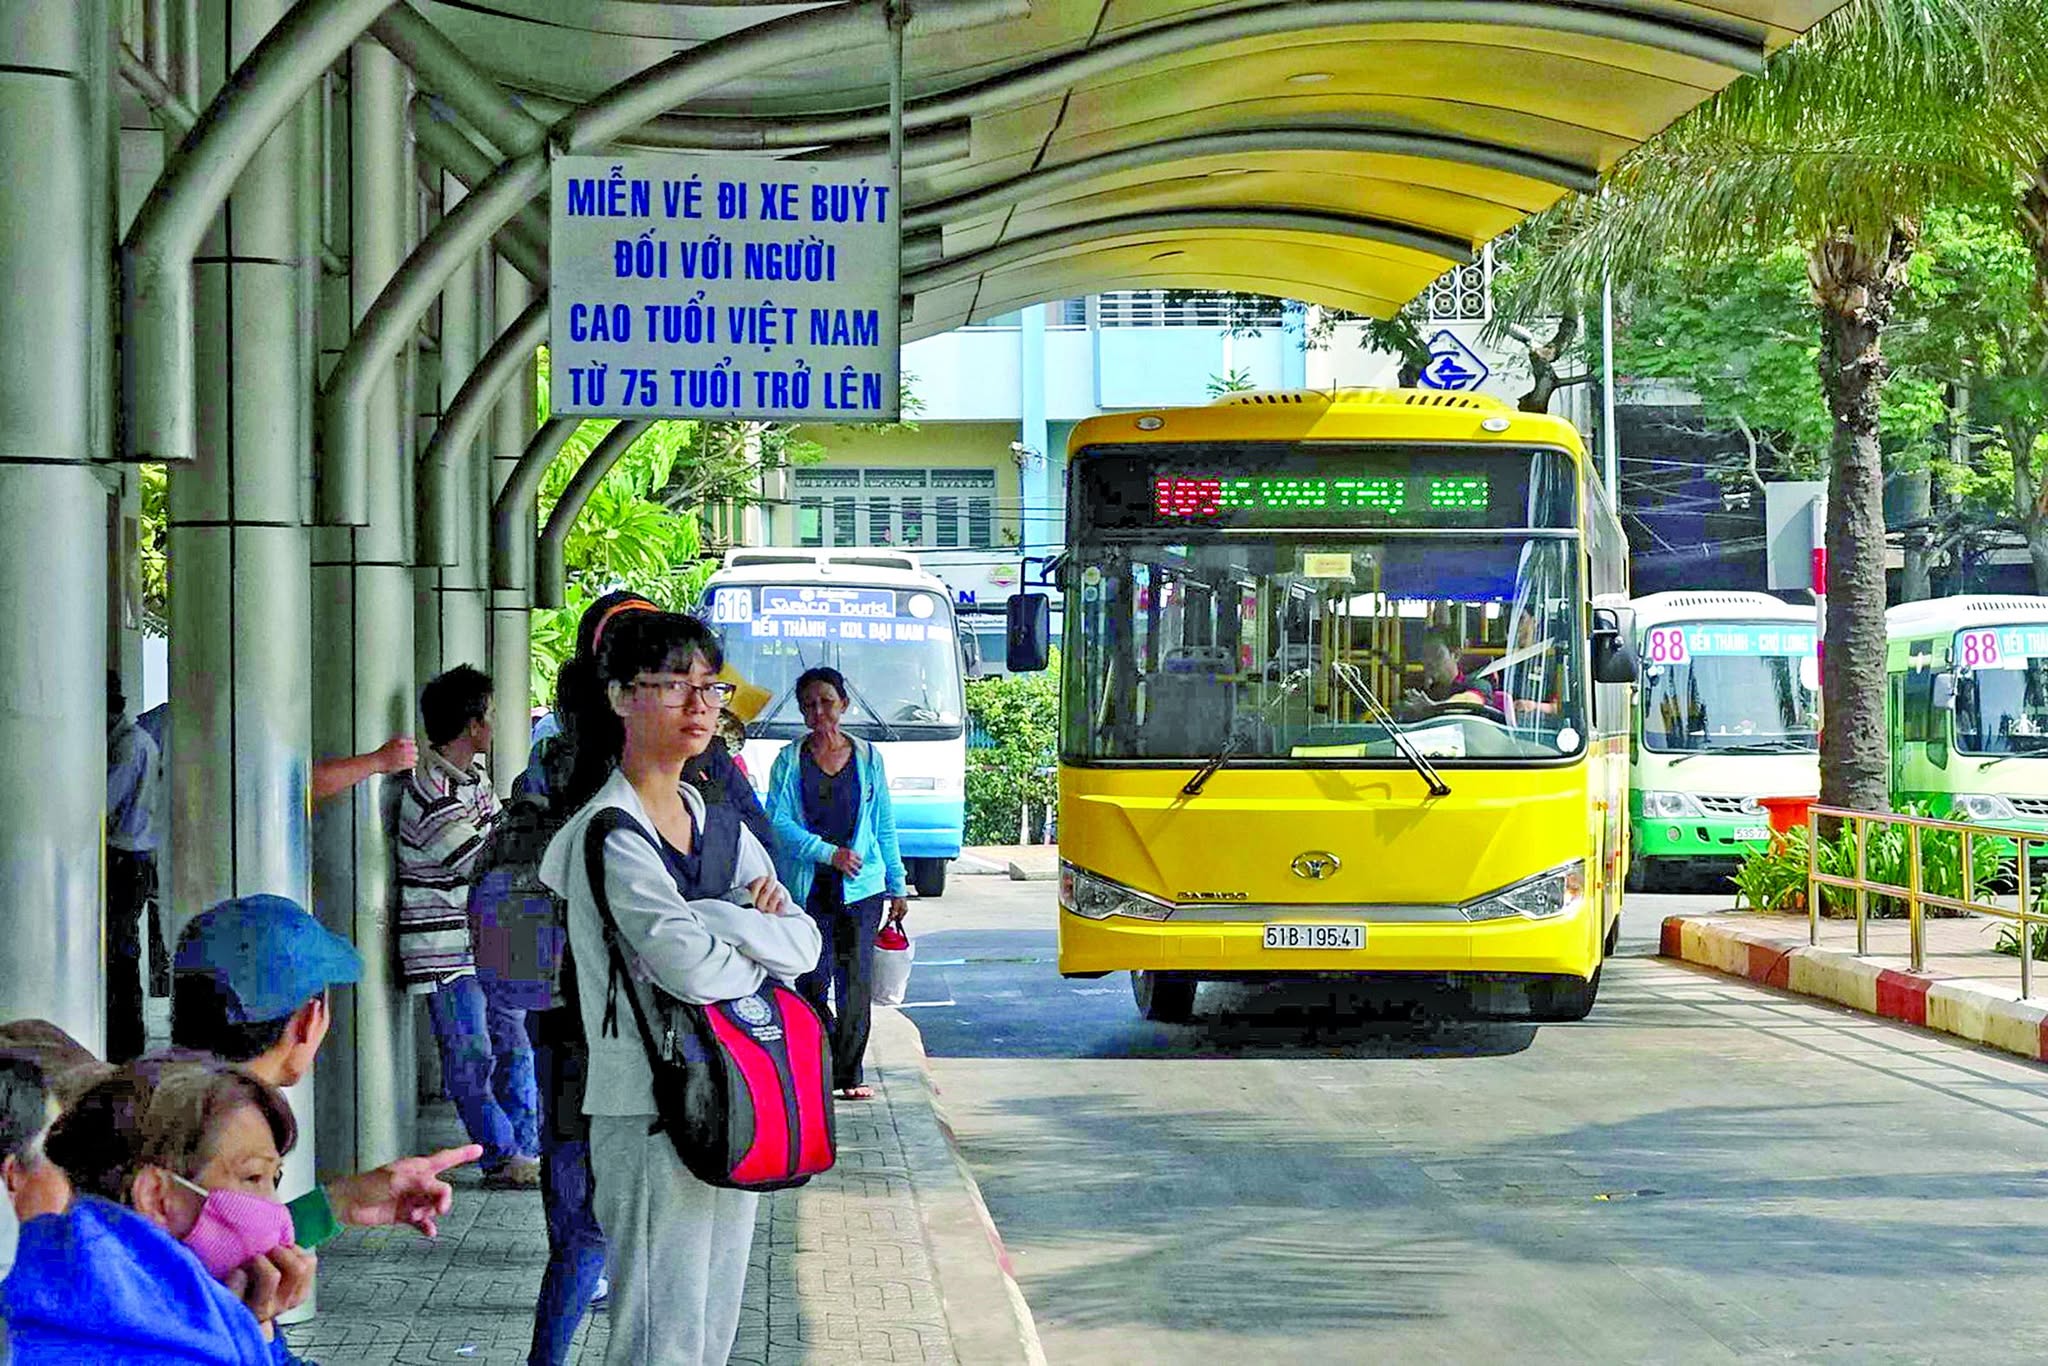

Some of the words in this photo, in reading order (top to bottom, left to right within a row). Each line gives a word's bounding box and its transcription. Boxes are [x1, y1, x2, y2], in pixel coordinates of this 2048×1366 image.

[568, 166, 650, 217] MIỄN
[663, 174, 703, 219] VÉ
[718, 181, 748, 220] ĐI
[760, 183, 799, 221] XE
[812, 179, 890, 223] BUÝT
[614, 228, 668, 279] ĐỐI
[681, 234, 733, 280] VỚI
[745, 235, 836, 282] NGƯỜI
[570, 303, 631, 344] CAO
[645, 290, 717, 345] TUỔI
[728, 300, 797, 353] VIỆT
[810, 309, 879, 347] NAM
[569, 360, 608, 407] TỪ
[620, 368, 659, 407] 75
[671, 356, 742, 409] TUỔI
[754, 359, 812, 410] TRỞ
[824, 365, 882, 411] LÊN
[717, 591, 749, 620] 616
[751, 614, 779, 637] BẾN
[782, 617, 827, 638] THÀNH
[840, 621, 866, 639] KDL
[1652, 630, 1684, 662] 88
[1964, 633, 1997, 666] 88
